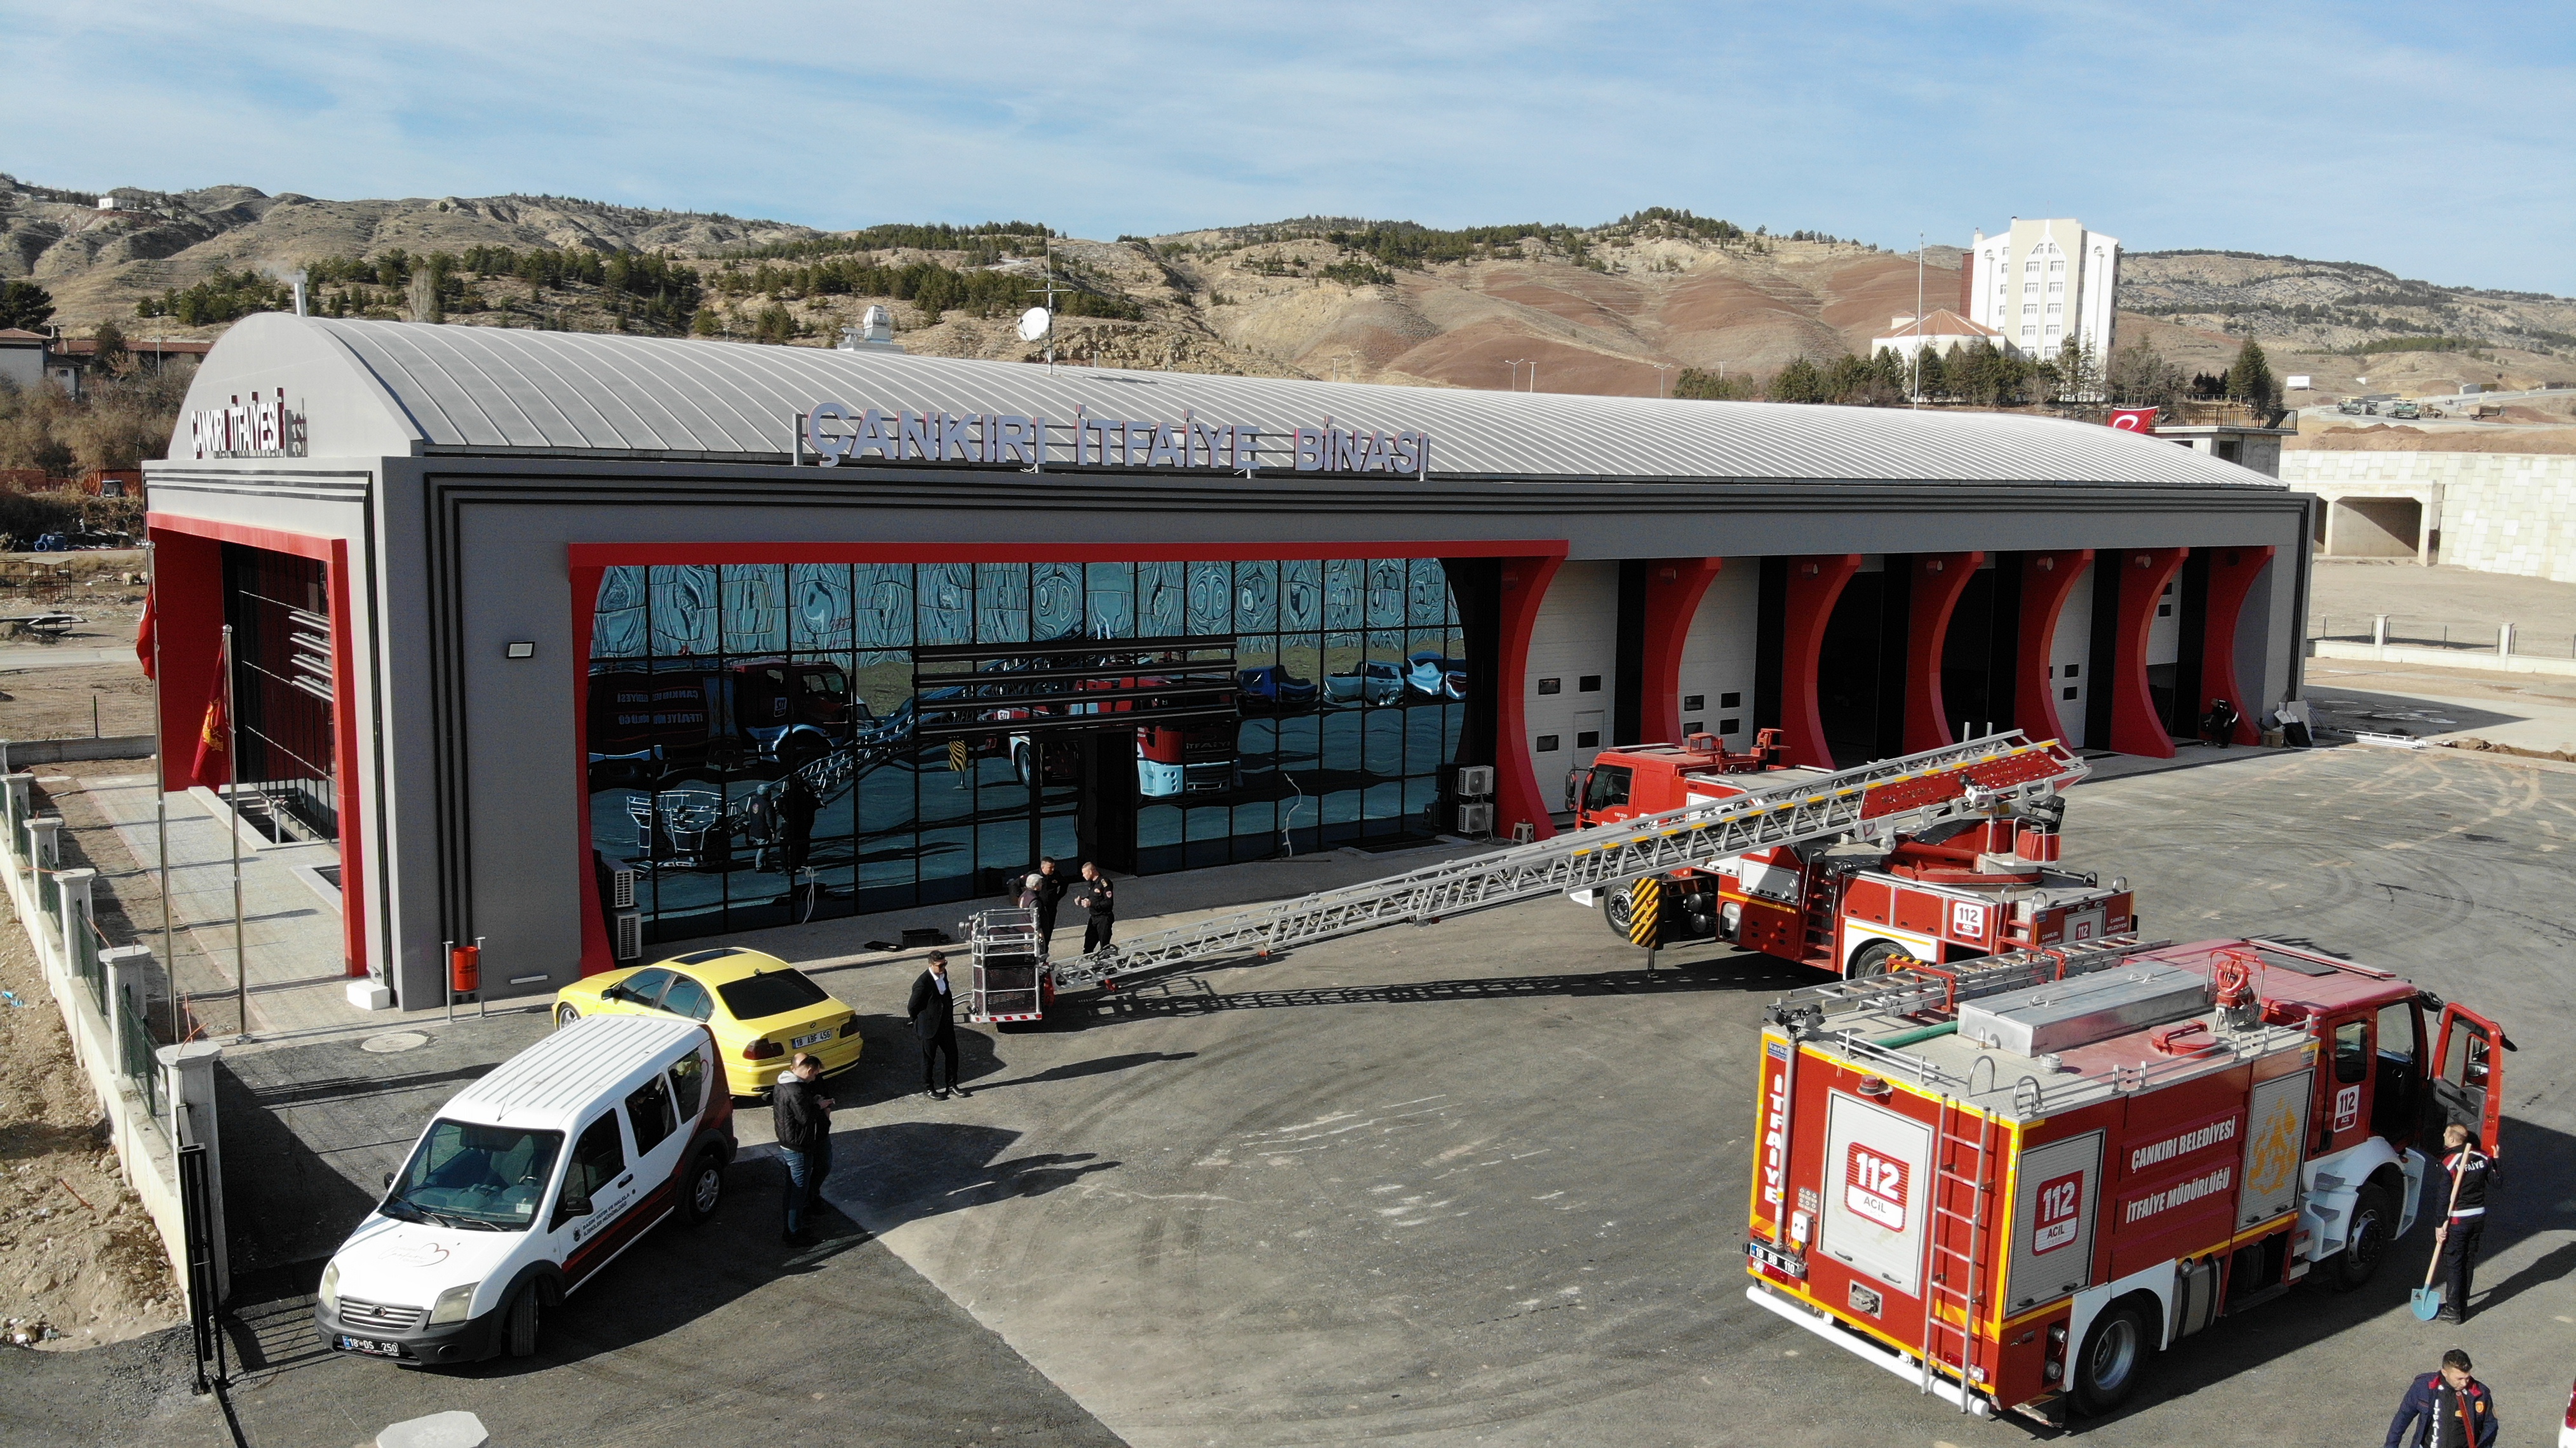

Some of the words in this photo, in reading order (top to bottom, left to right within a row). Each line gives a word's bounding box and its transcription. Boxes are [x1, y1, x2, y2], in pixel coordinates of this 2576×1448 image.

[191, 408, 227, 459] ÇANKIRI
[807, 402, 1046, 467] ÇANKIRI
[1076, 404, 1261, 469] İTFAİYE
[1294, 415, 1428, 473] BİNASI
[1959, 907, 1978, 923] 112
[2078, 925, 2088, 939] 112
[2340, 1091, 2356, 1114] 112
[1764, 1074, 1785, 1205] İTFAİYE
[2131, 1137, 2178, 1174] ÇANKIRI
[2178, 1115, 2236, 1155] BELEDİYESİ
[1856, 1153, 1900, 1200] 112
[2126, 1192, 2166, 1224] İTFAİYE
[2166, 1166, 2231, 1209] MÜDÜRLÜĞÜ
[2043, 1182, 2075, 1222] 112
[1755, 1247, 1764, 1259] 18
[1784, 1261, 1795, 1274] 110
[381, 1343, 398, 1353] 250
